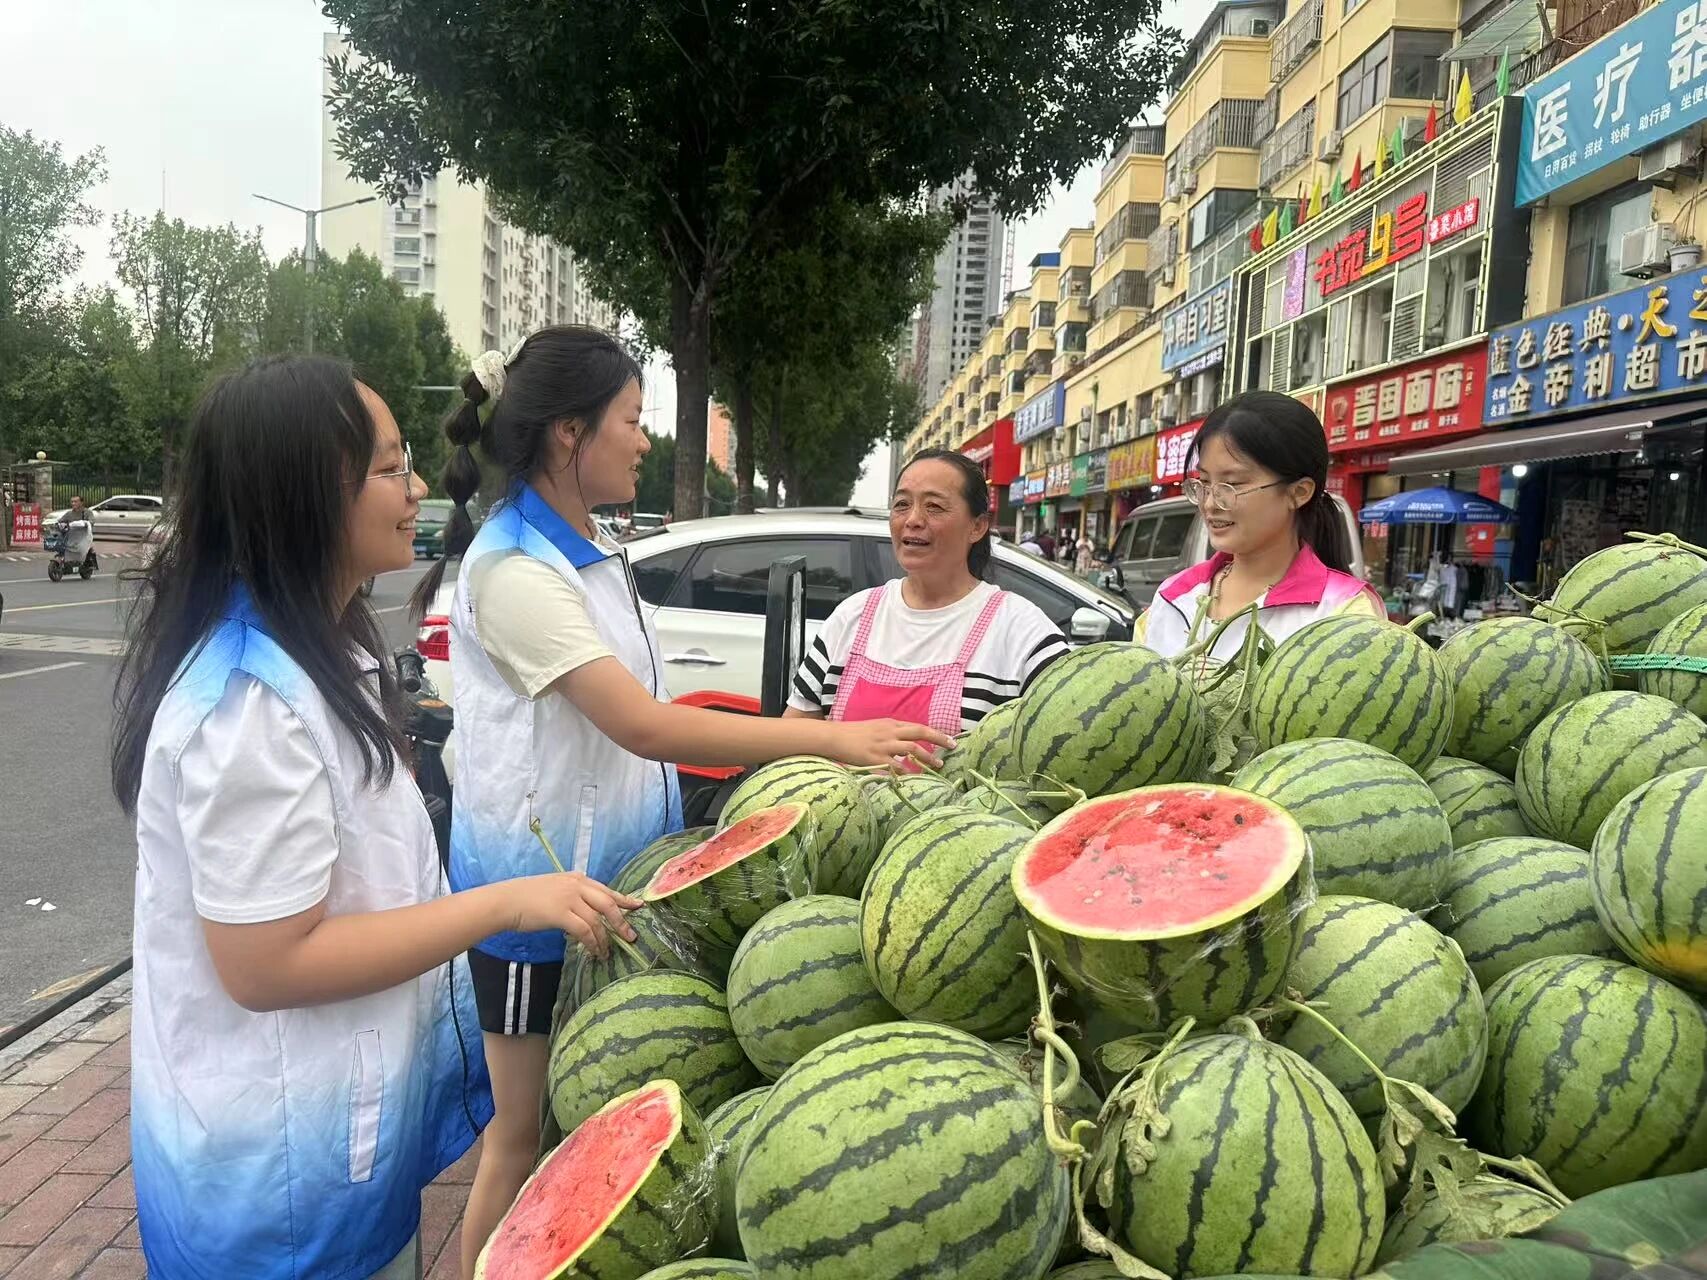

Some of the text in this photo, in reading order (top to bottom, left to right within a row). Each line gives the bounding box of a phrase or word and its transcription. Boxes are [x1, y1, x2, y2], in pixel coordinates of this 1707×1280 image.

[1544, 82, 1707, 179] 日用百货 拐杖 轮椅 助行器 坐便
